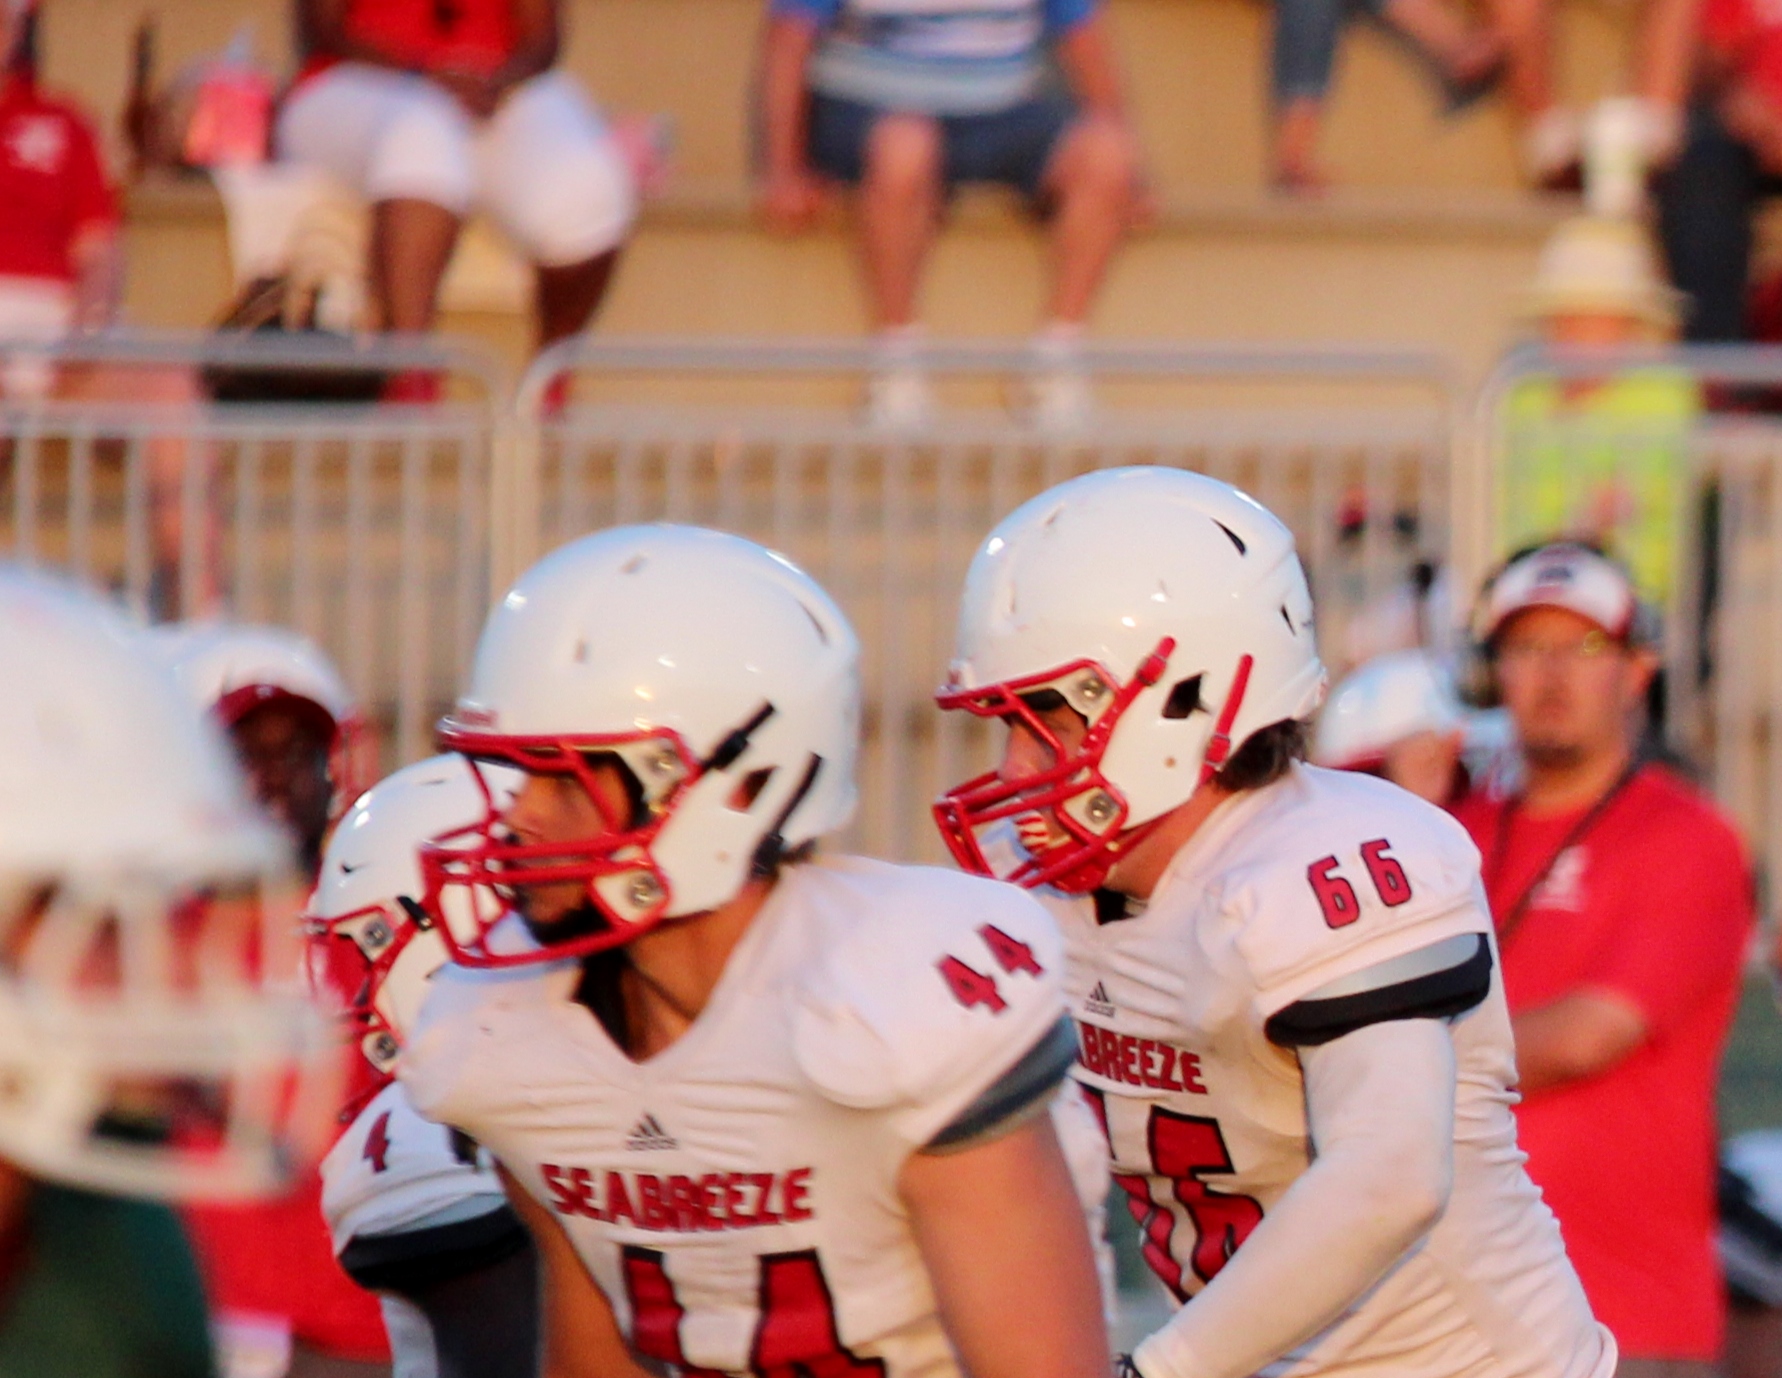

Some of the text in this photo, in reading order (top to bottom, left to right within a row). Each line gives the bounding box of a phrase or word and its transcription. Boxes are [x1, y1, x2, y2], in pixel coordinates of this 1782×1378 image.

[1306, 838, 1412, 929] 66
[934, 922, 1043, 1016] 44
[1075, 1020, 1208, 1095] BREEZE
[362, 1110, 392, 1174] 4
[539, 1163, 816, 1233] SEABREEZE
